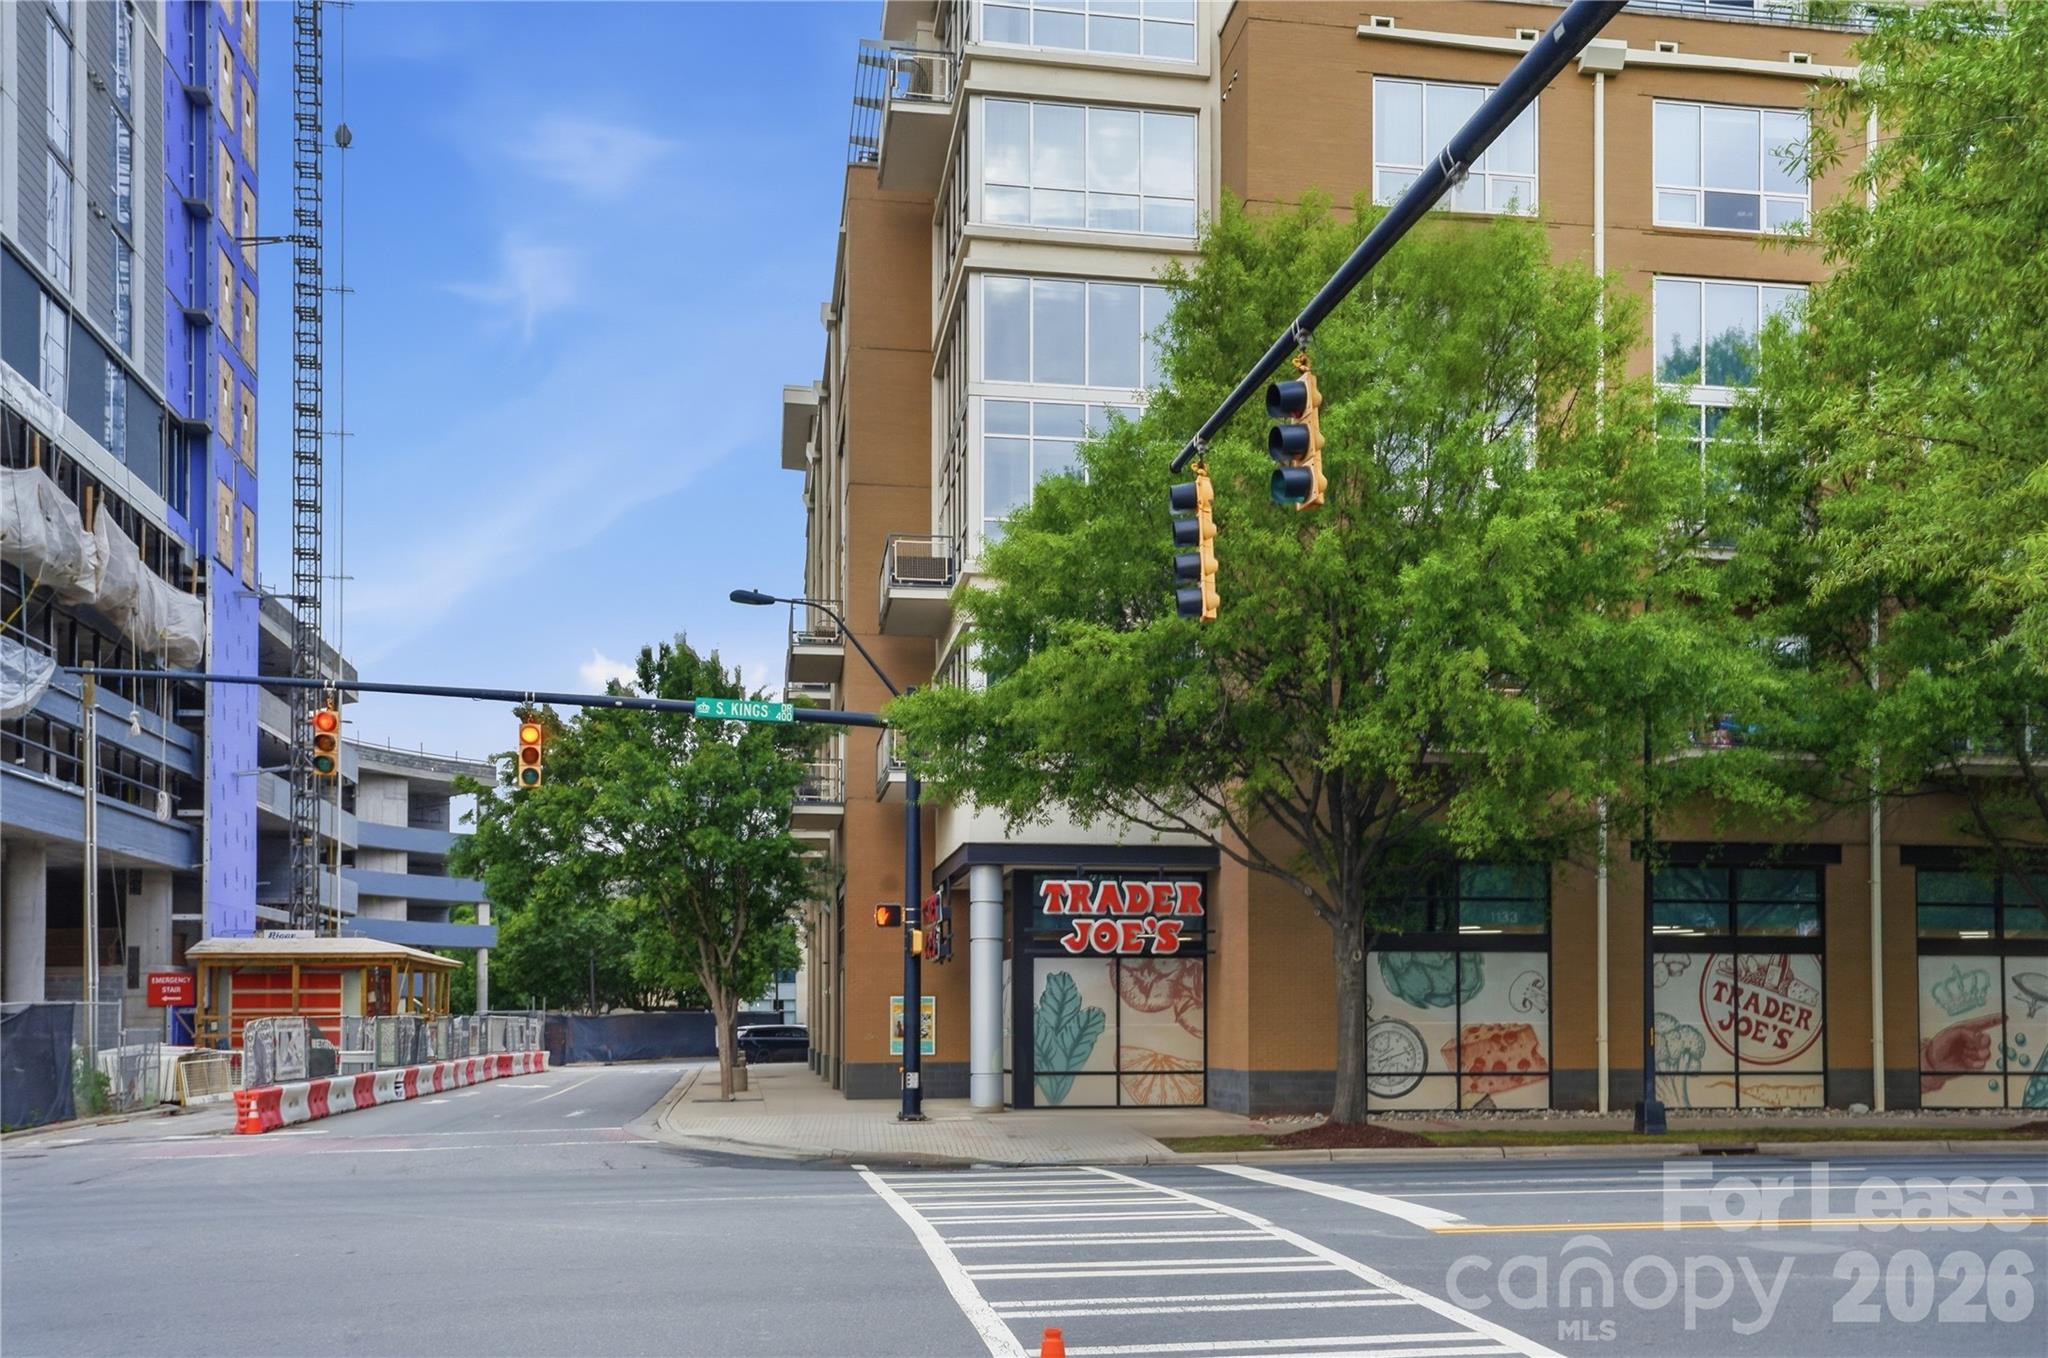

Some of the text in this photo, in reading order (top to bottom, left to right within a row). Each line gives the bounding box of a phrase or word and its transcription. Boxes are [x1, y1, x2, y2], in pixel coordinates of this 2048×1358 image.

[716, 702, 769, 718] S. KINGS
[776, 712, 793, 722] 400
[781, 703, 793, 713] DR
[1039, 880, 1205, 916] TRADER
[1060, 916, 1184, 954] JOE'S
[151, 976, 191, 984] EMERGENCY
[1712, 980, 1813, 1031] TRADER
[1718, 1010, 1794, 1050] JOE'S
